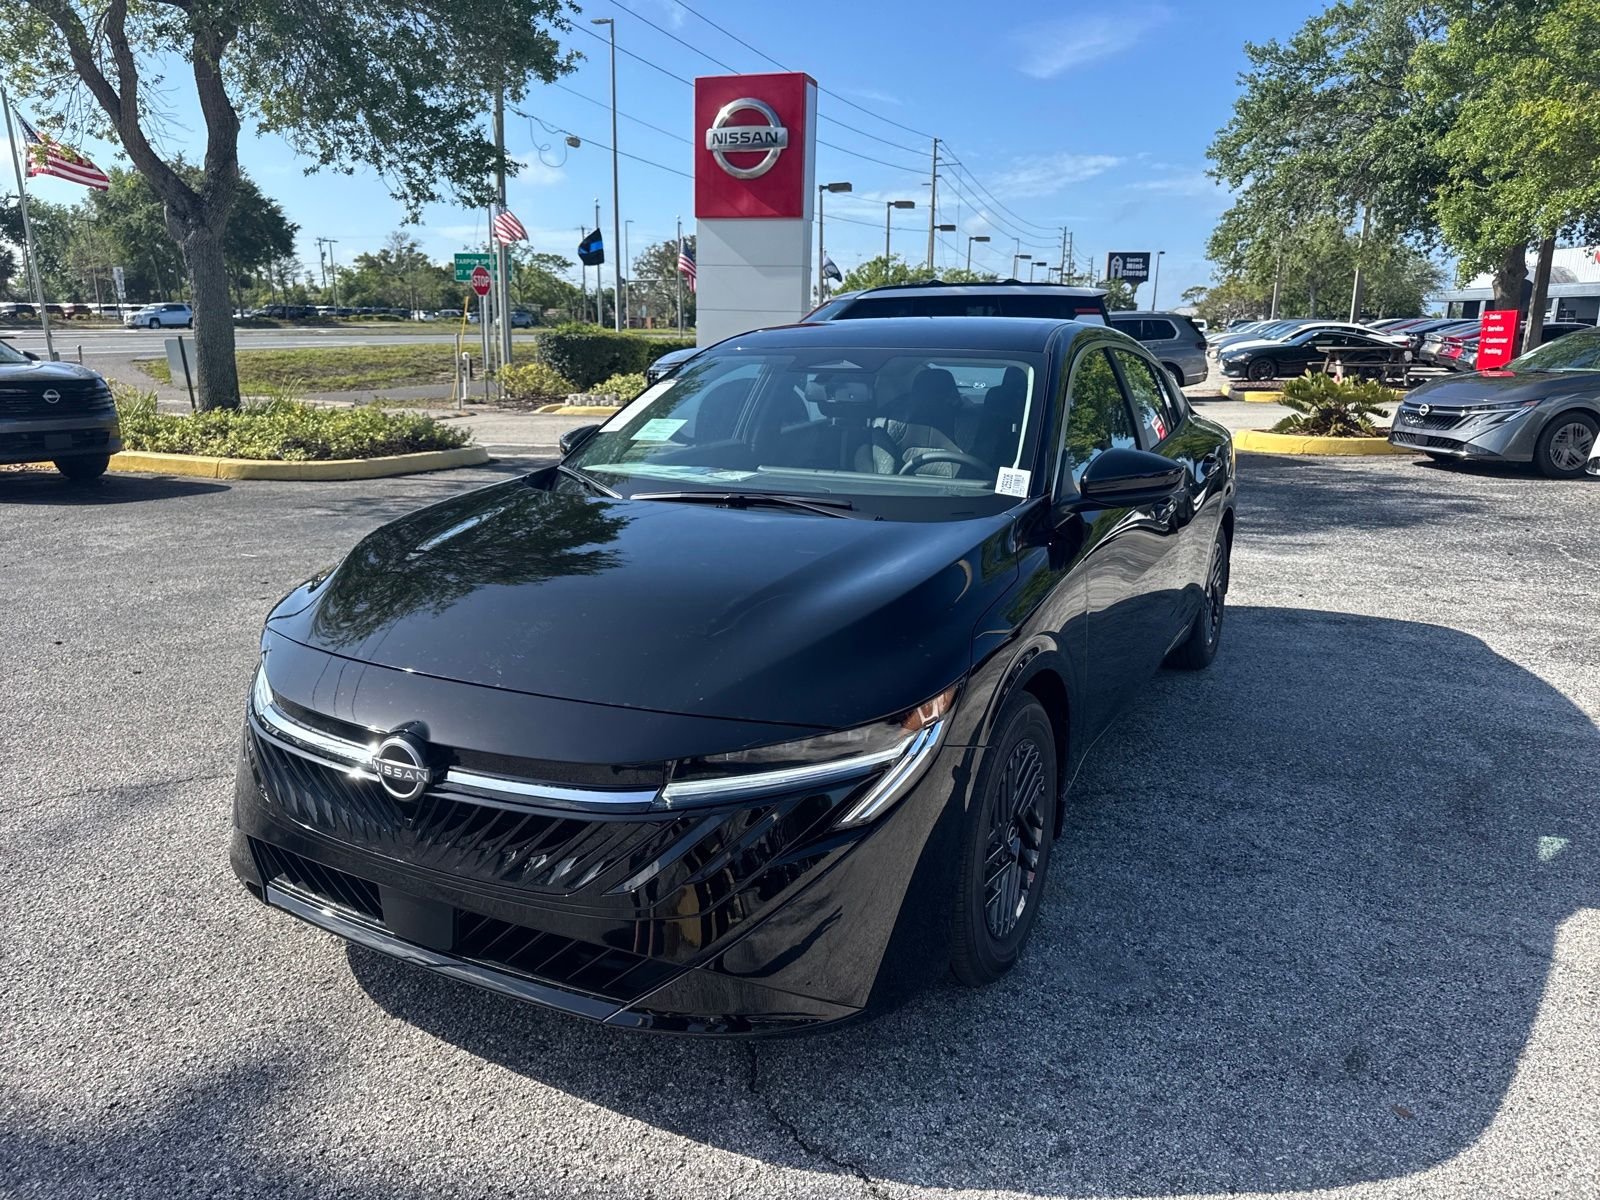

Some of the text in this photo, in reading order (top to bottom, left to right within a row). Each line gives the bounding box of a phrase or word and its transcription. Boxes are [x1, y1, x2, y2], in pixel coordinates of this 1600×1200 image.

[712, 131, 778, 145] NISSAN
[1122, 269, 1147, 277] Storage
[473, 275, 490, 287] STOP
[372, 759, 427, 781] NISSAN
